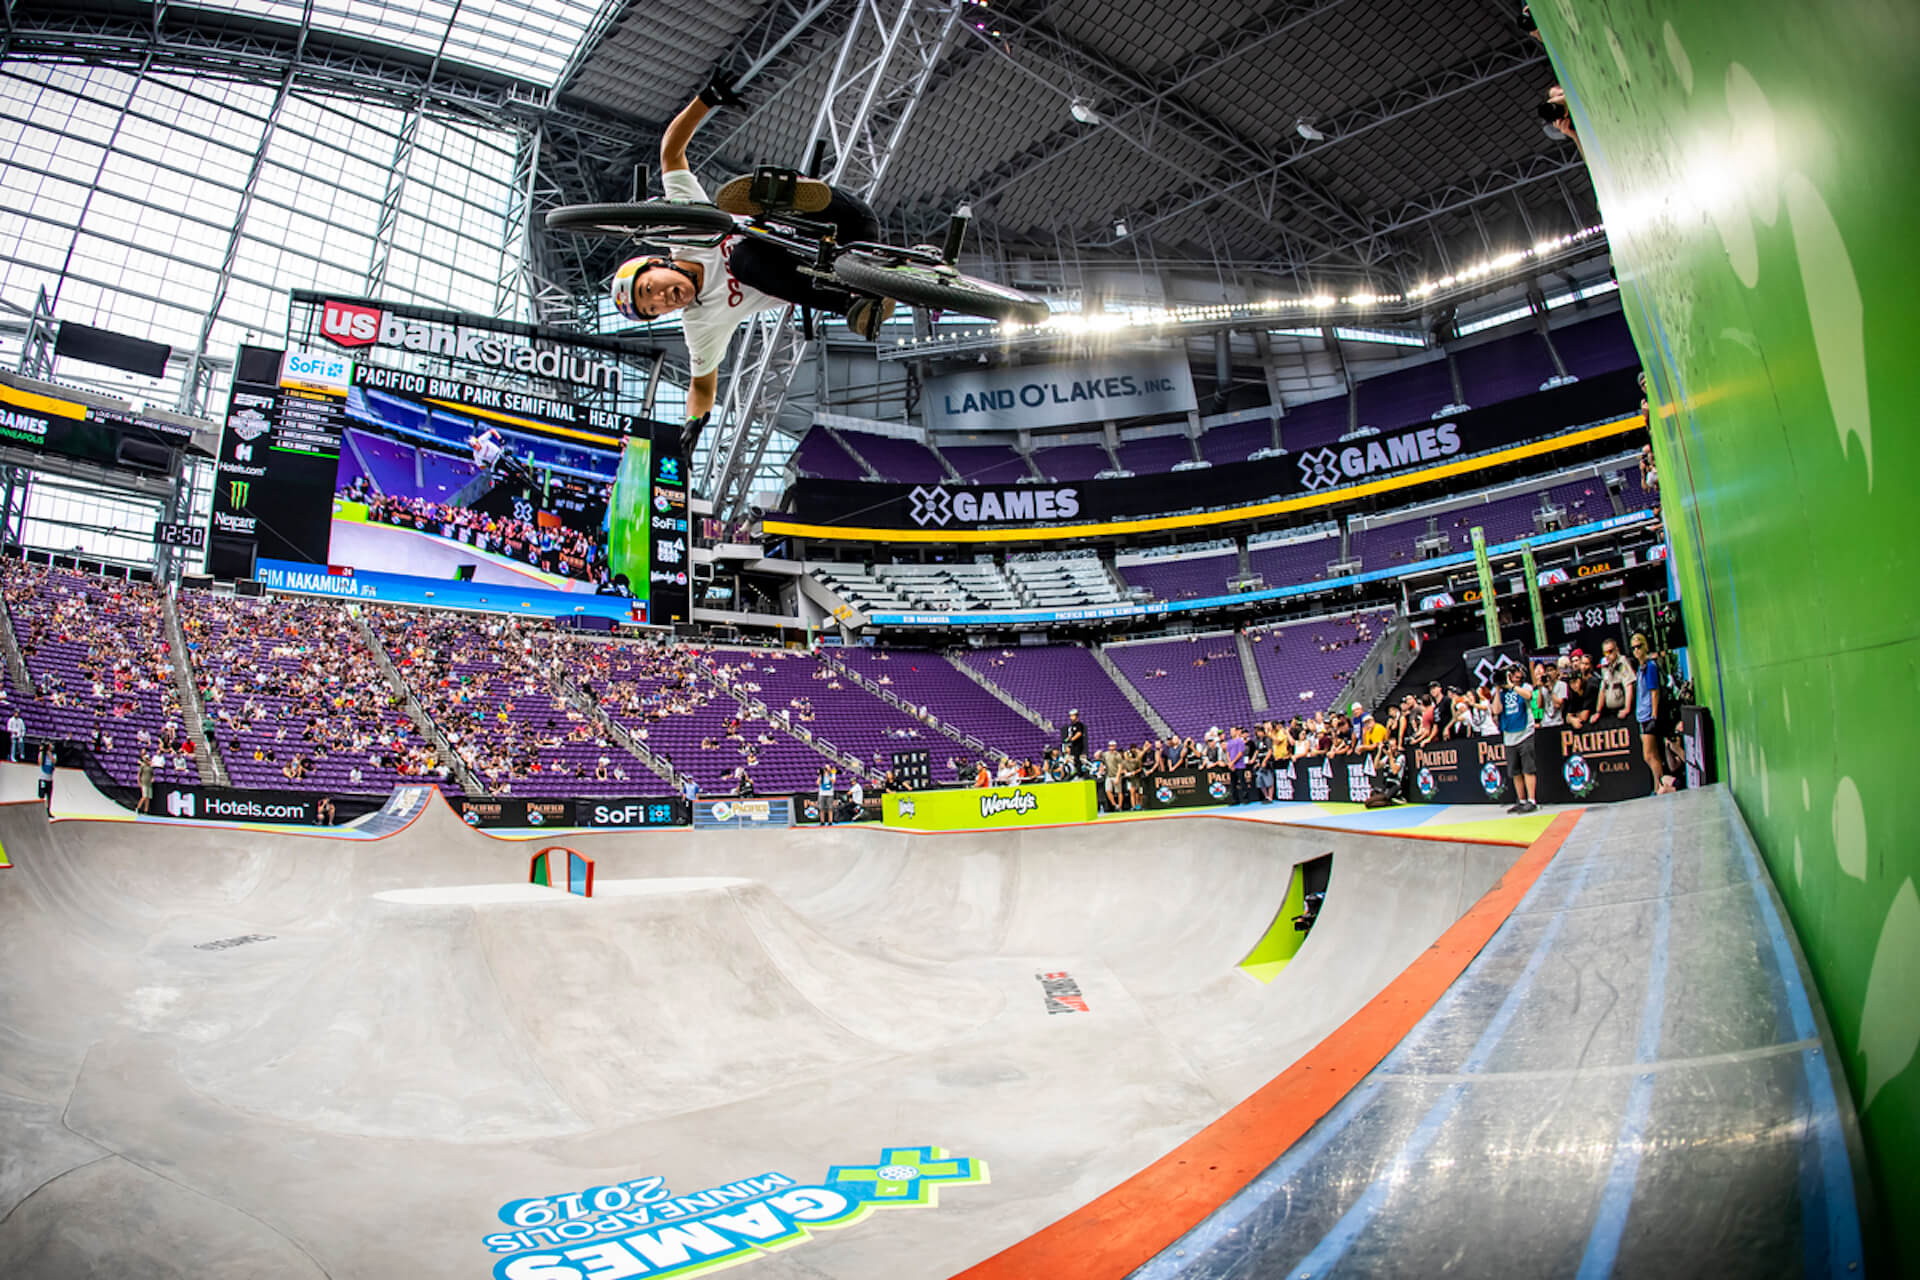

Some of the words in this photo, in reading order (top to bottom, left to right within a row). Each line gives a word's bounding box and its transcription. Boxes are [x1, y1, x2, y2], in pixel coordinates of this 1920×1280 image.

[289, 356, 326, 375] SoFi
[356, 365, 426, 394] PACIFICO
[428, 378, 461, 400] BMX
[463, 384, 502, 407] PARK
[503, 392, 577, 421] SEMIFINAL
[589, 408, 622, 430] HEAT
[623, 416, 633, 432] 2
[945, 389, 1015, 415] LAND
[1144, 377, 1175, 393] INC.
[1340, 422, 1461, 477] GAMES
[953, 488, 1080, 521] GAMES
[161, 524, 203, 546] 12:50
[652, 516, 676, 531] SoFi
[1577, 563, 1611, 577] CLARA
[286, 571, 358, 595] NAKAMURA
[1561, 728, 1631, 756] PACIFICO
[1415, 749, 1457, 768] PACIFICO
[205, 798, 304, 818] Hotels.com
[594, 805, 645, 823] SoFi
[980, 790, 1037, 817] Wendy's
[486, 1172, 790, 1253] MINNEAPOLIS
[513, 1176, 670, 1227] 2019
